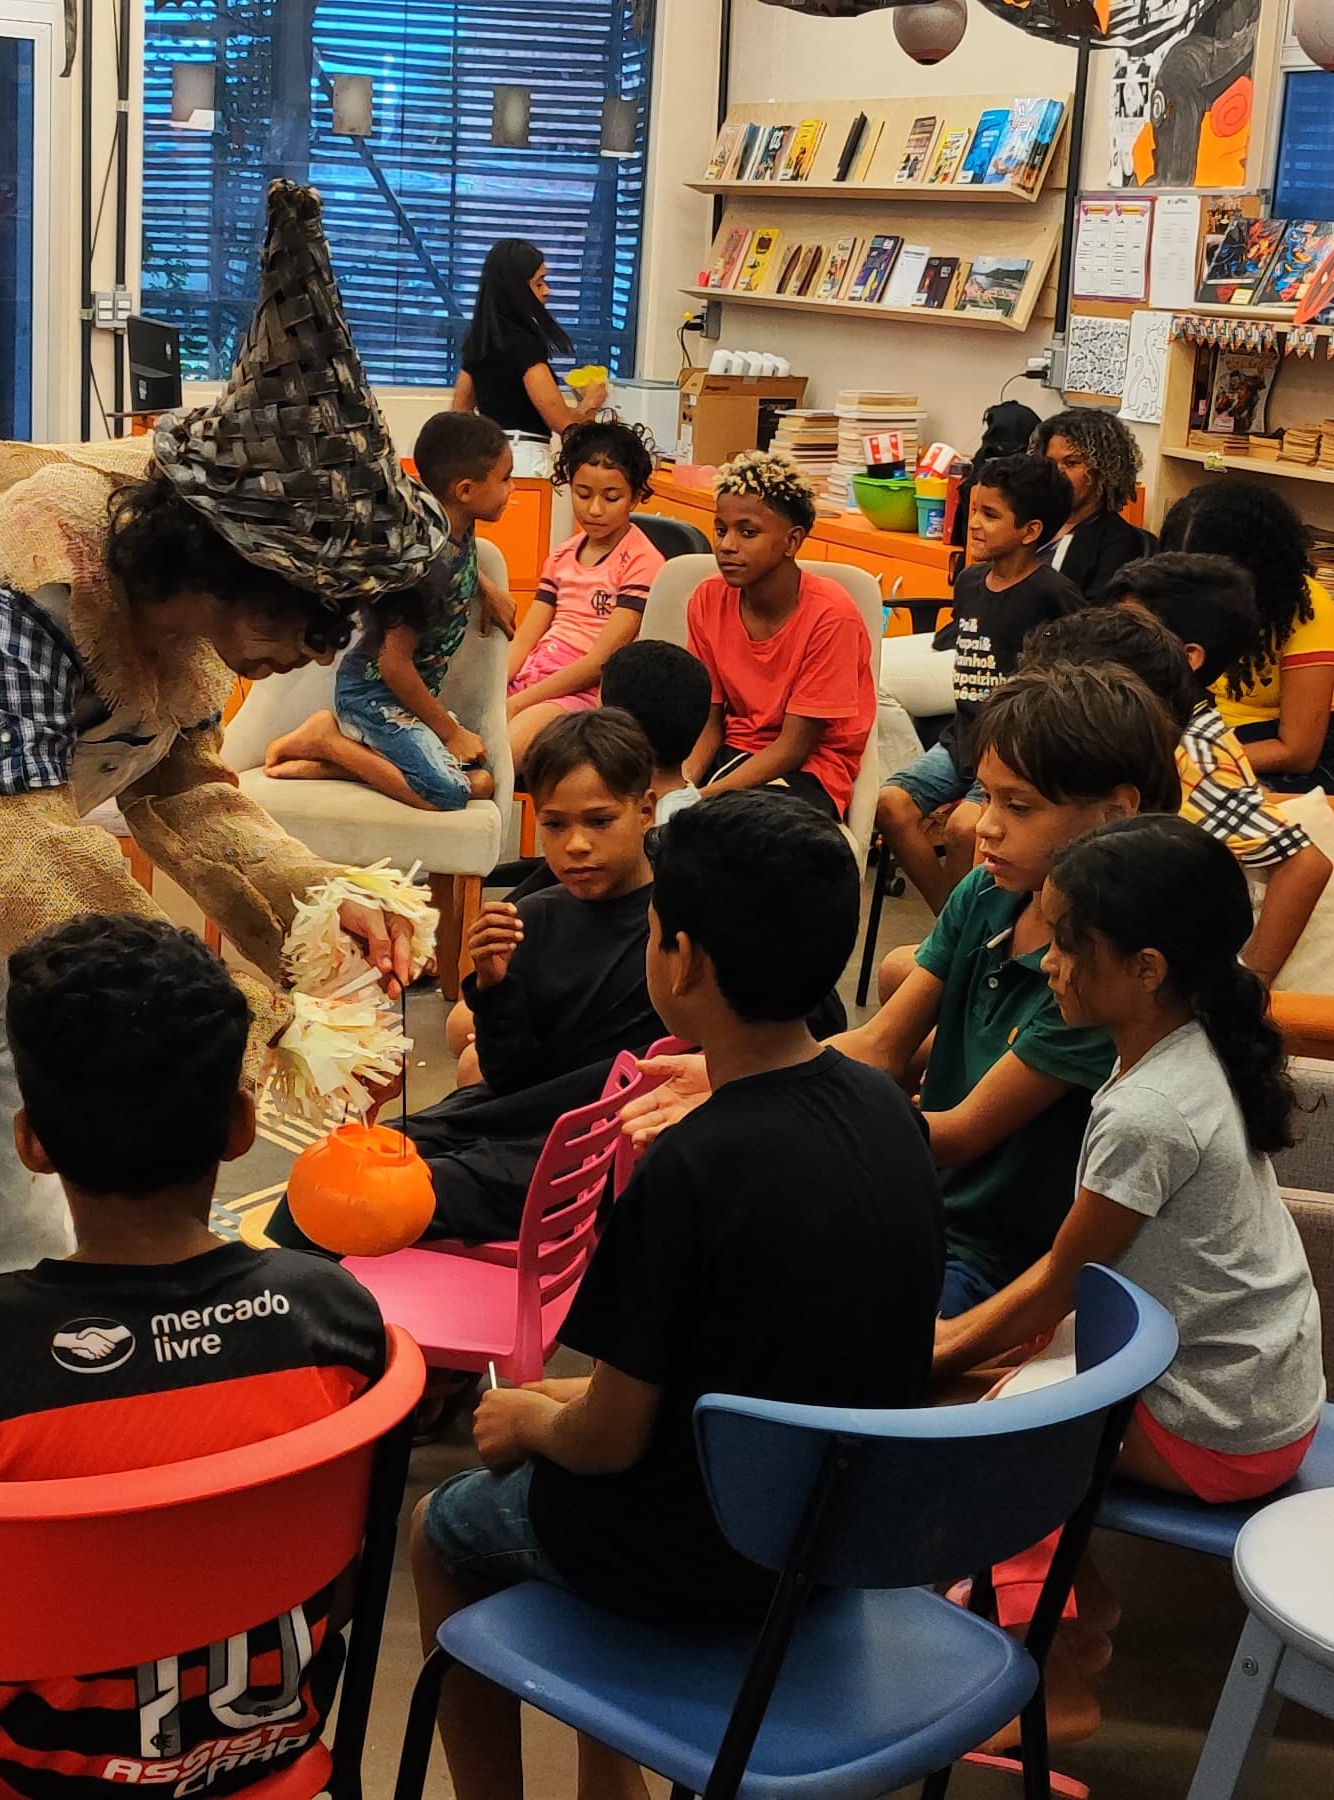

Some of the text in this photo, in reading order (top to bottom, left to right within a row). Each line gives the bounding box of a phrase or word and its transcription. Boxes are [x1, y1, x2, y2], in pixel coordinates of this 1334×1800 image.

[150, 1290, 291, 1336] mercado
[154, 1332, 222, 1364] livre
[102, 1722, 300, 1785] ASSIST
